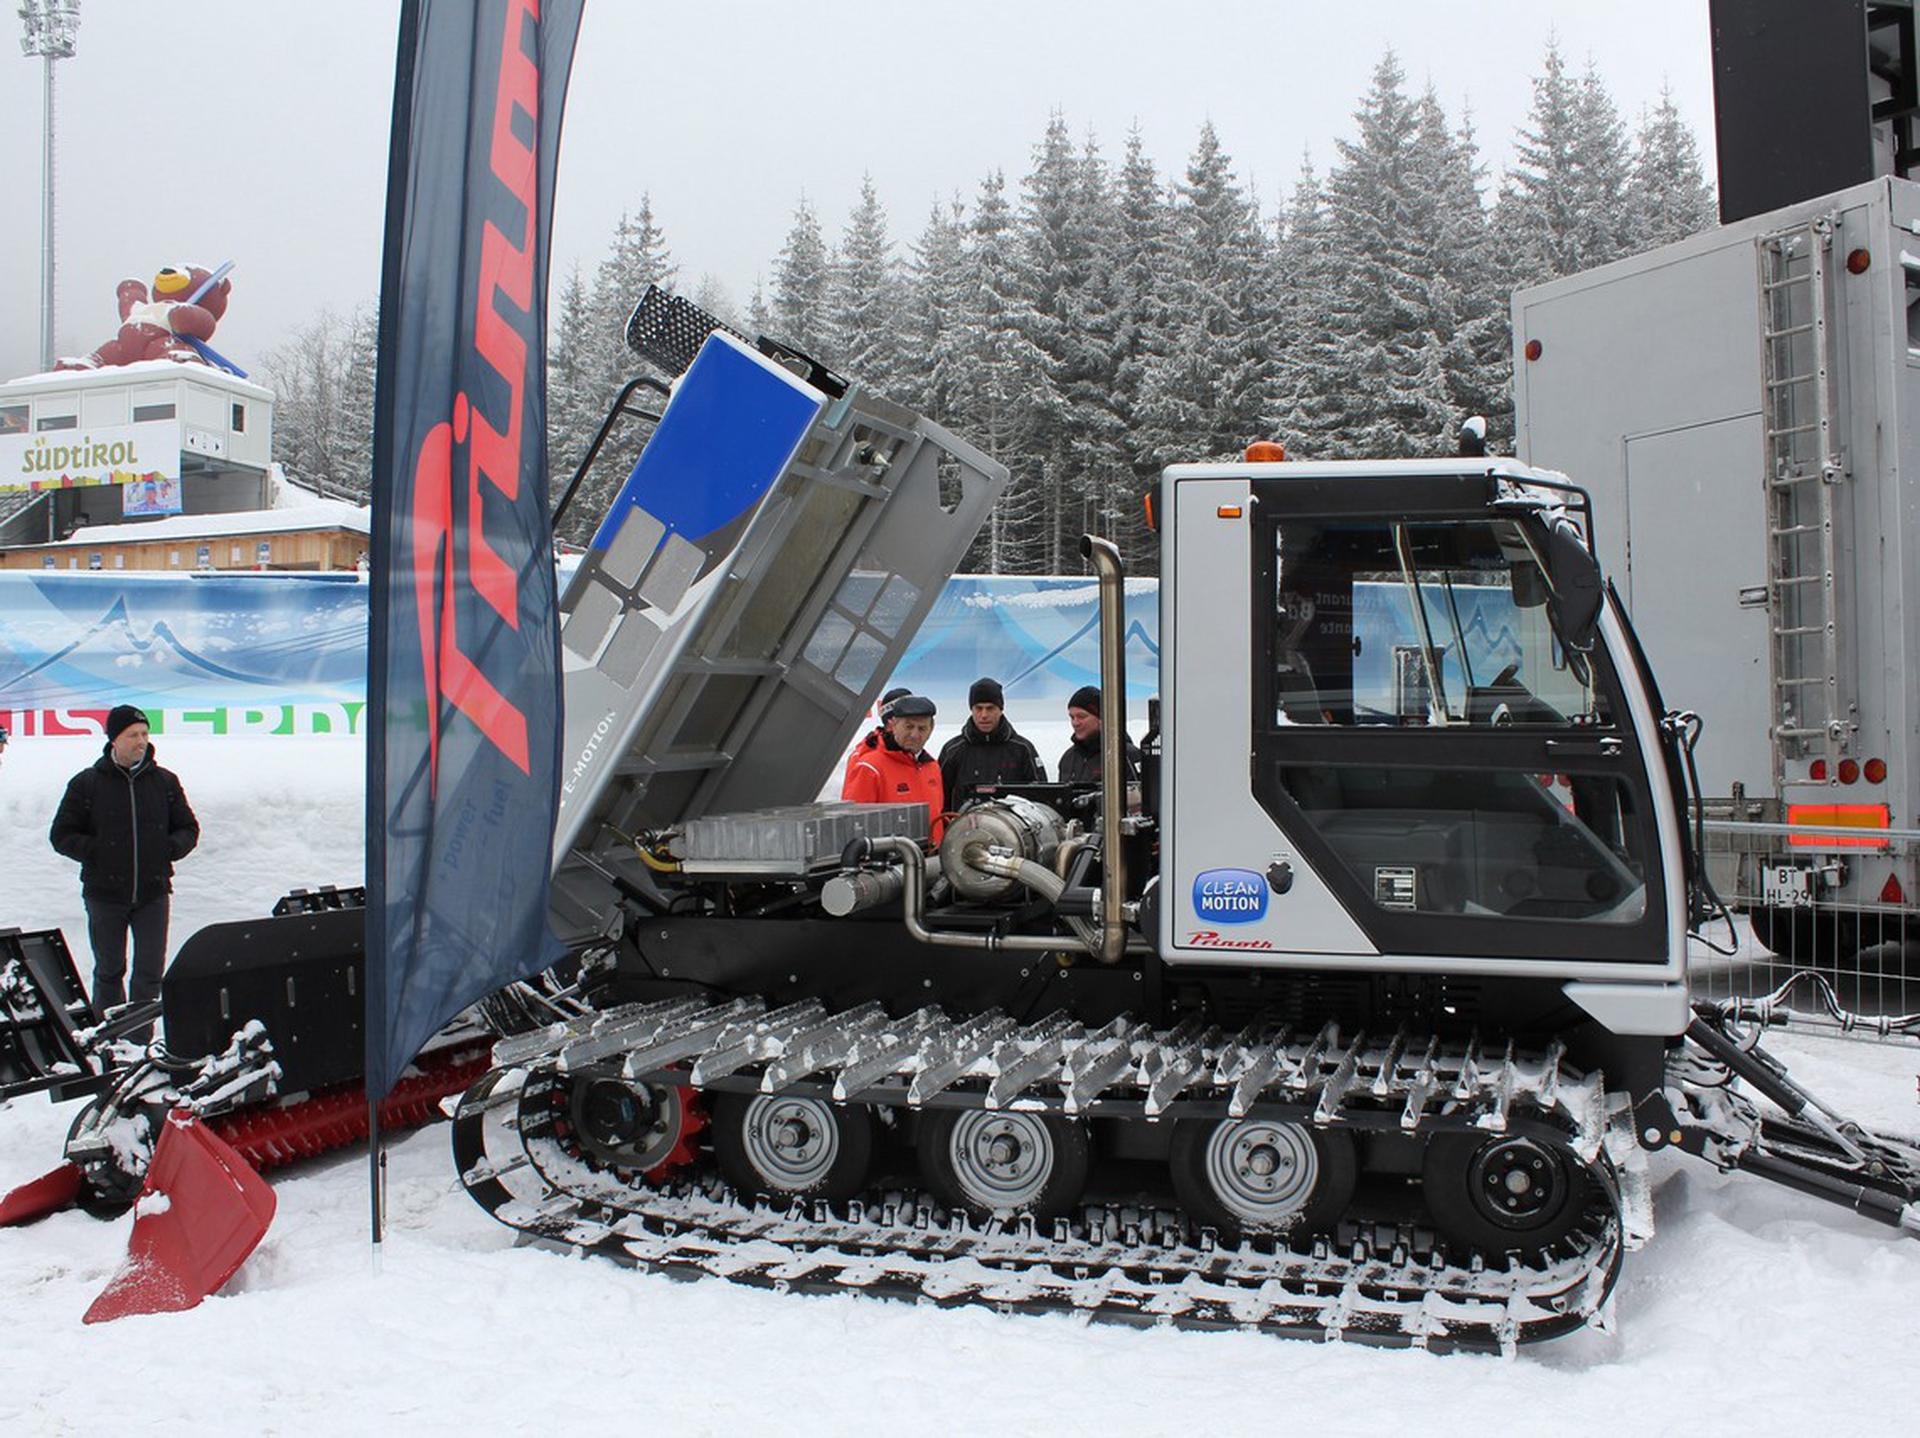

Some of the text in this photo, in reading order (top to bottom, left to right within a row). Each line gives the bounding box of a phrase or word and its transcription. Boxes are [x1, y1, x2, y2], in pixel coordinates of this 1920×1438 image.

[483, 778, 513, 827] fuel
[443, 798, 477, 869] power
[1779, 869, 1797, 884] BT
[1202, 881, 1259, 896] CLEAN
[1201, 896, 1259, 910] MOTION
[1187, 931, 1273, 948] Prinoth
